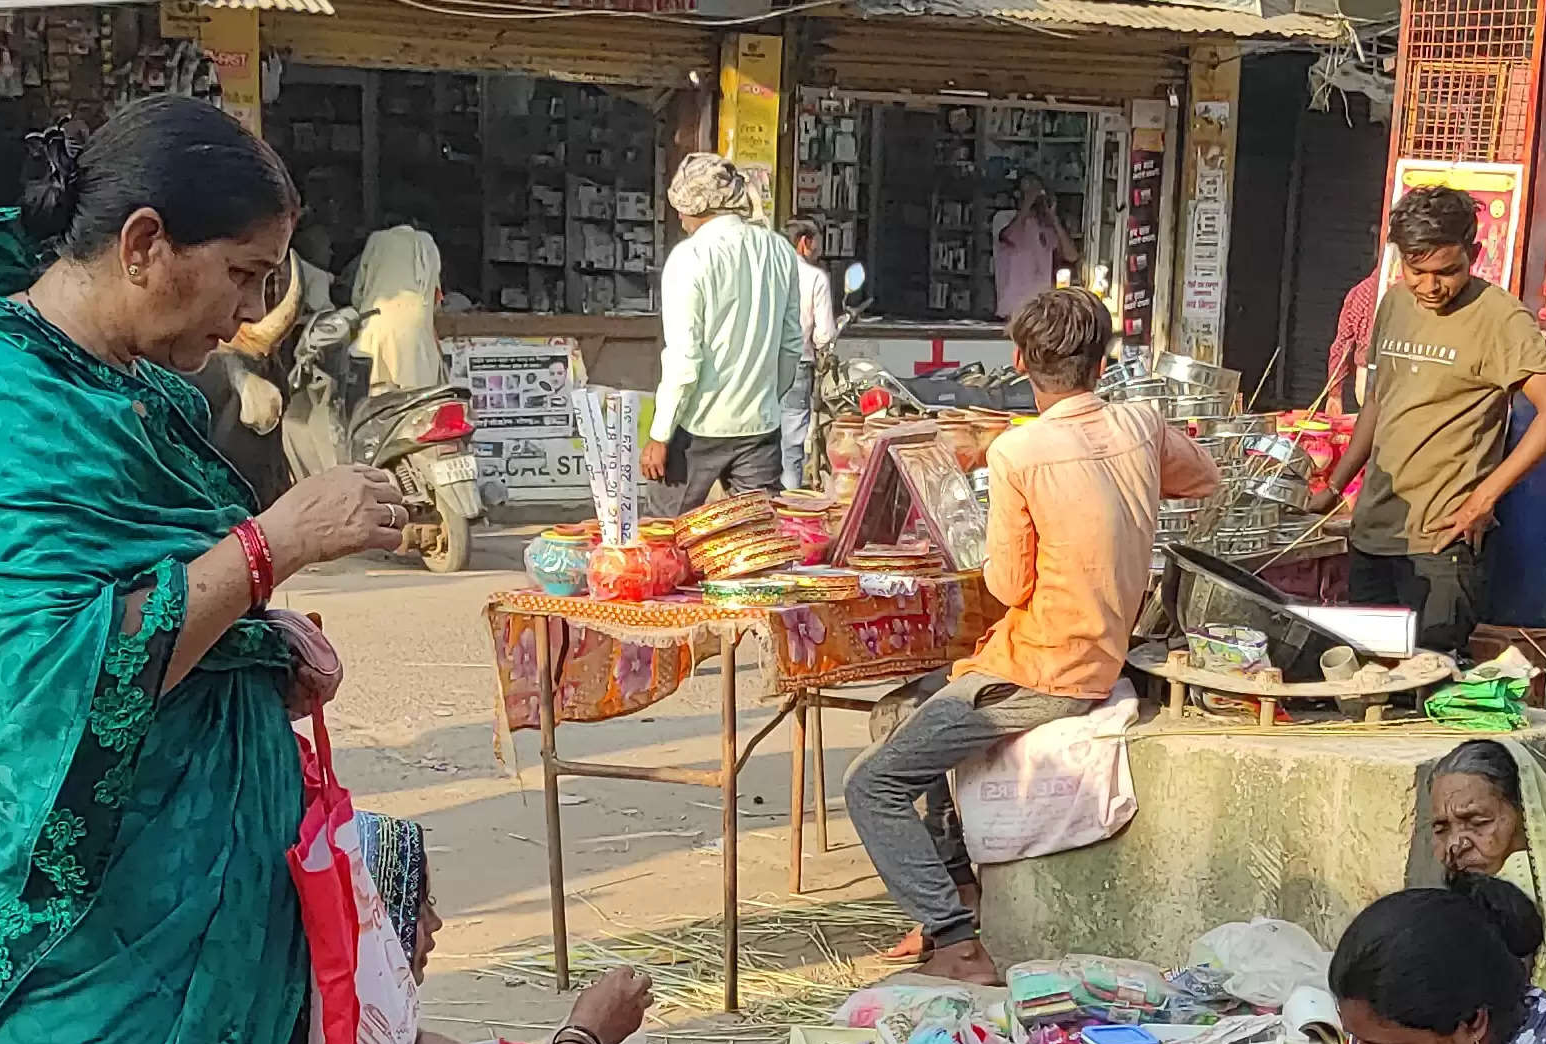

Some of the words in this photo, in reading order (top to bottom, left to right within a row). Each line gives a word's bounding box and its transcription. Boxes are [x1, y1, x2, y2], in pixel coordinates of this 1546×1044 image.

[620, 463, 632, 483] 28
[620, 493, 632, 512] 27
[621, 522, 632, 545] 26
